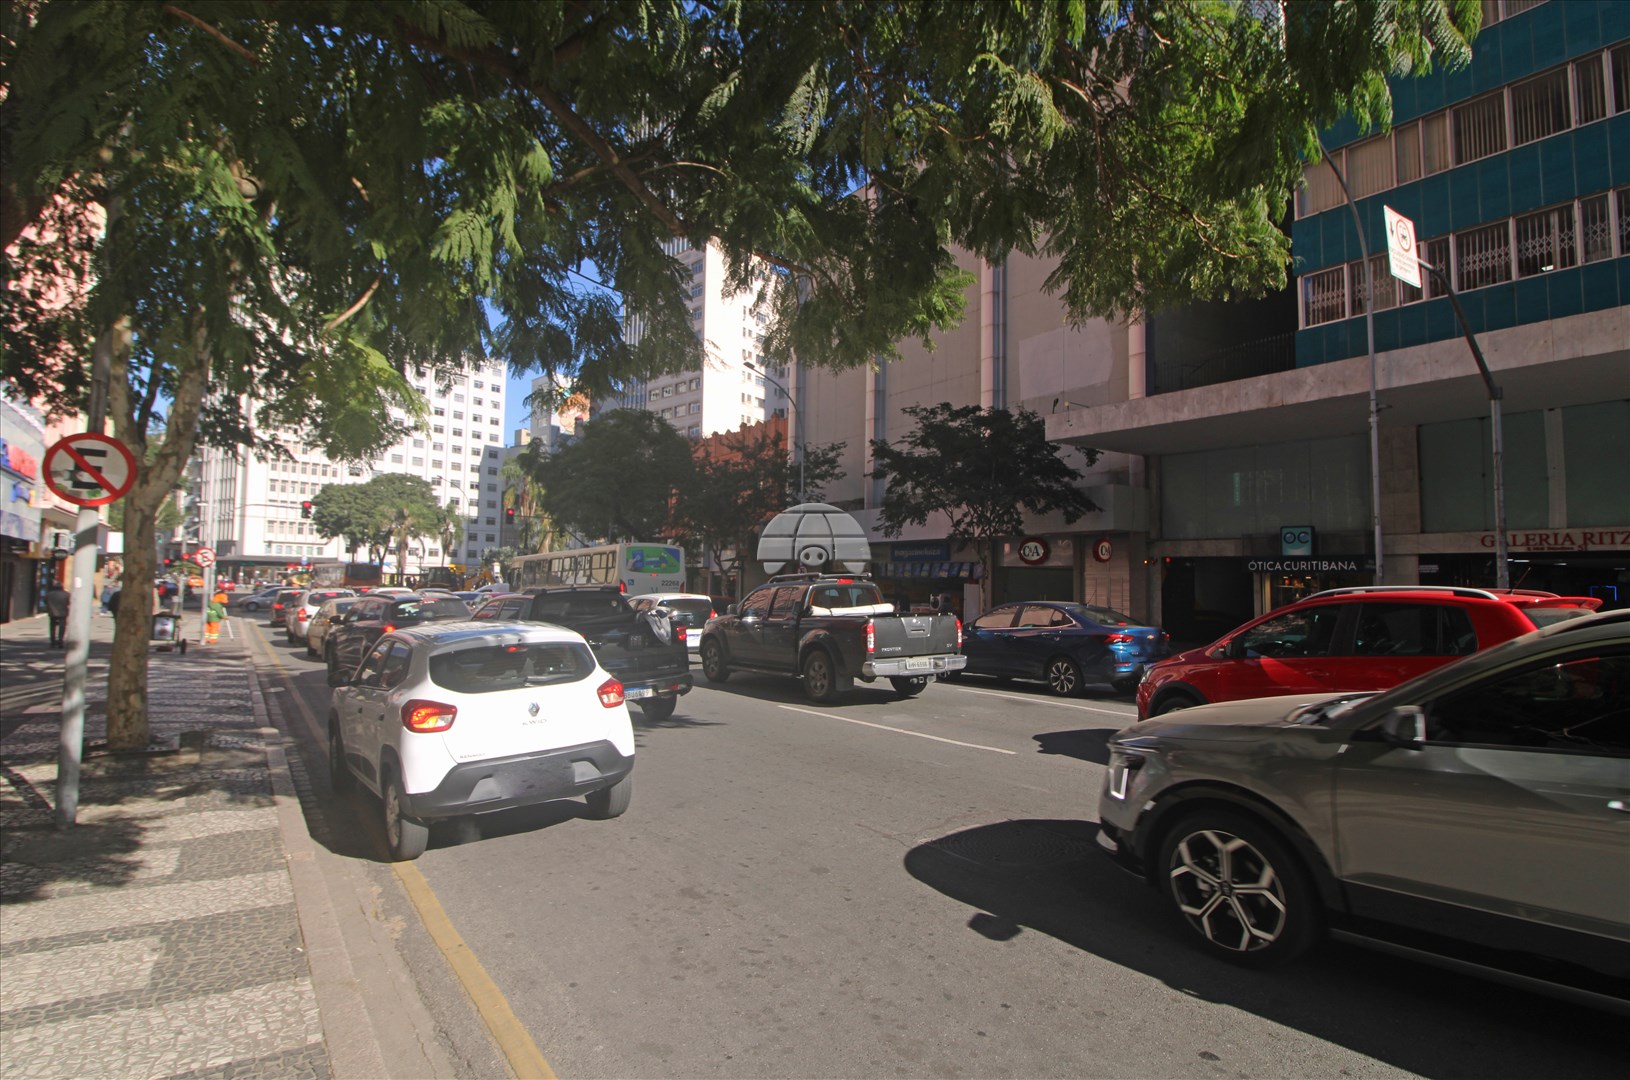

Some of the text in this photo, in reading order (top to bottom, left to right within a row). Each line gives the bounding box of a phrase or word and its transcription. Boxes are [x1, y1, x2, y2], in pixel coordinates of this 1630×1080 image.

[1283, 531, 1310, 544] OC
[1480, 530, 1630, 548] GLERIA RITZ
[1248, 560, 1282, 571] ÓTICA
[1283, 560, 1357, 571] CURITIBANA
